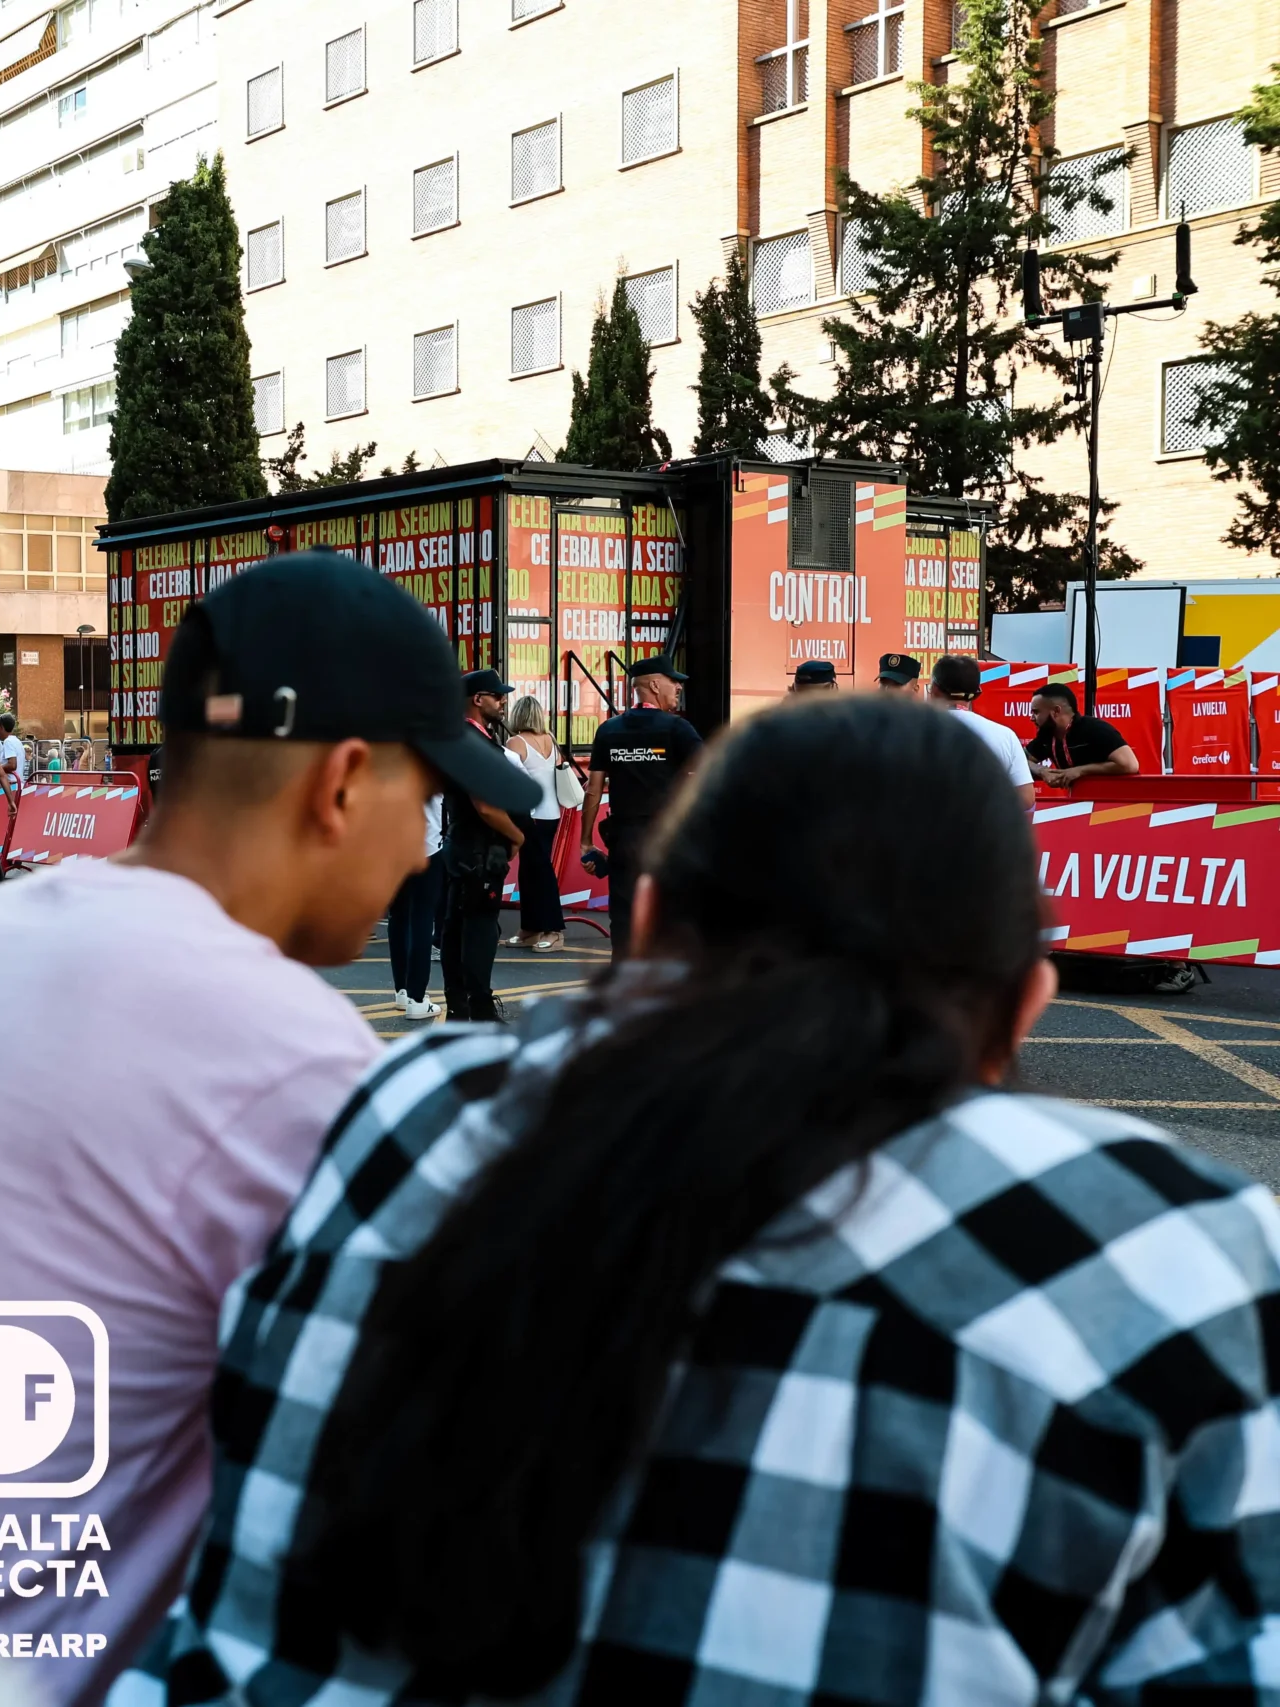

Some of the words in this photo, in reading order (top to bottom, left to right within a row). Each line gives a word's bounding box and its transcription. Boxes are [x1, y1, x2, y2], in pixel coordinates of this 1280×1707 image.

[511, 496, 582, 531] CELERA
[585, 515, 625, 534] CADA
[136, 541, 185, 572] CELEBRA
[379, 541, 415, 574] CADA
[623, 575, 661, 606] ADA
[770, 571, 872, 624] CONTROL
[563, 608, 626, 641] CELEBRA
[904, 620, 944, 649] LEBRA
[790, 639, 803, 658] LA
[804, 640, 846, 659] VUELTA
[1004, 702, 1016, 717] LA
[1098, 704, 1131, 718] VUELTA
[1201, 701, 1227, 716] VUELTA
[43, 812, 57, 836] LA
[57, 812, 96, 840] VUELTA
[1039, 851, 1080, 898] LA
[1094, 853, 1246, 908] VUELTA
